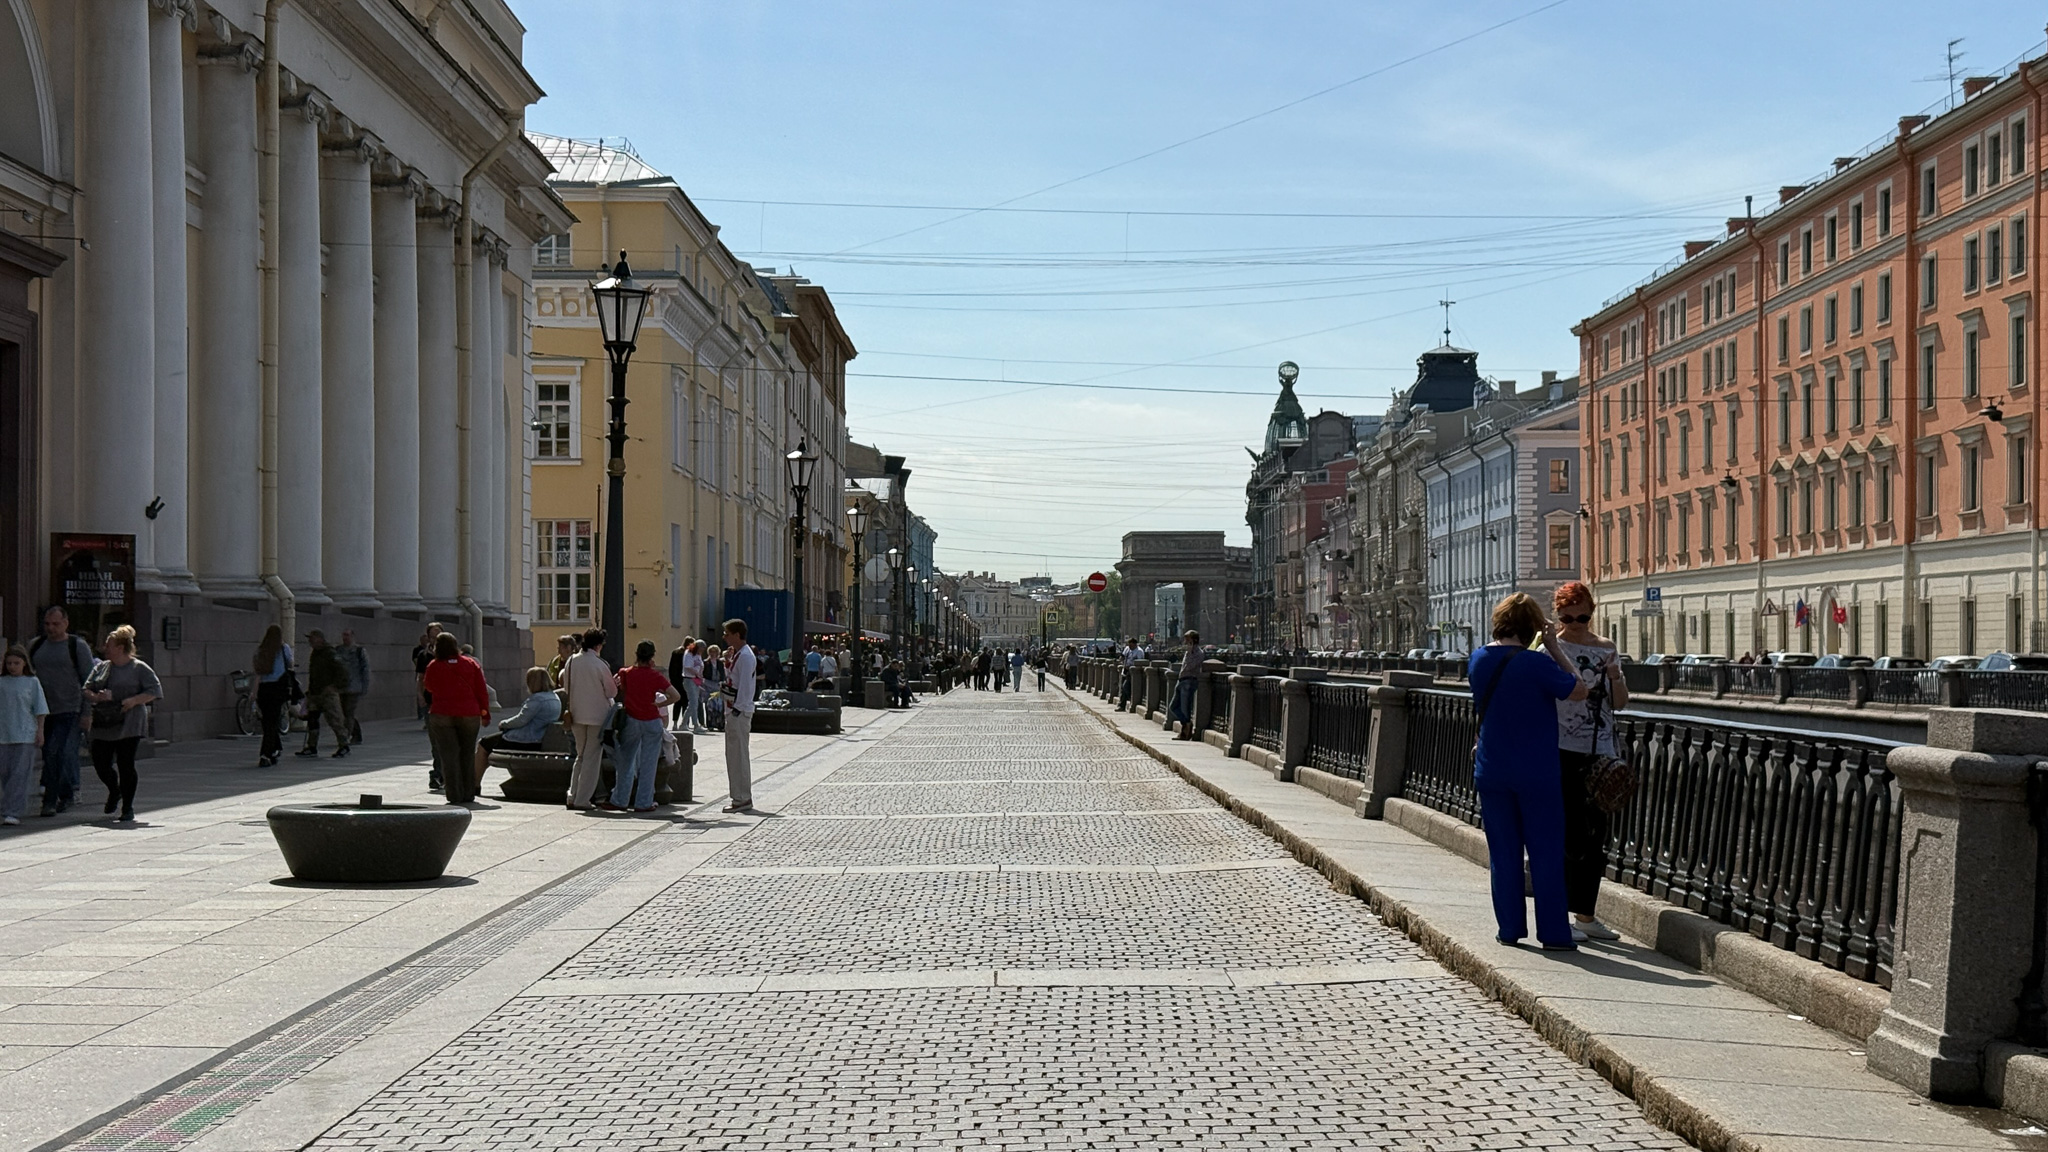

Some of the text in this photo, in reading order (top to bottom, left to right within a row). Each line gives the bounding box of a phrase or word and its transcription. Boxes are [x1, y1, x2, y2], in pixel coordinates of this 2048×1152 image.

[78, 571, 113, 581] ИВАН
[65, 580, 125, 591] ШИШКИН
[107, 590, 125, 599] ЛЕС
[1649, 588, 1659, 600] P
